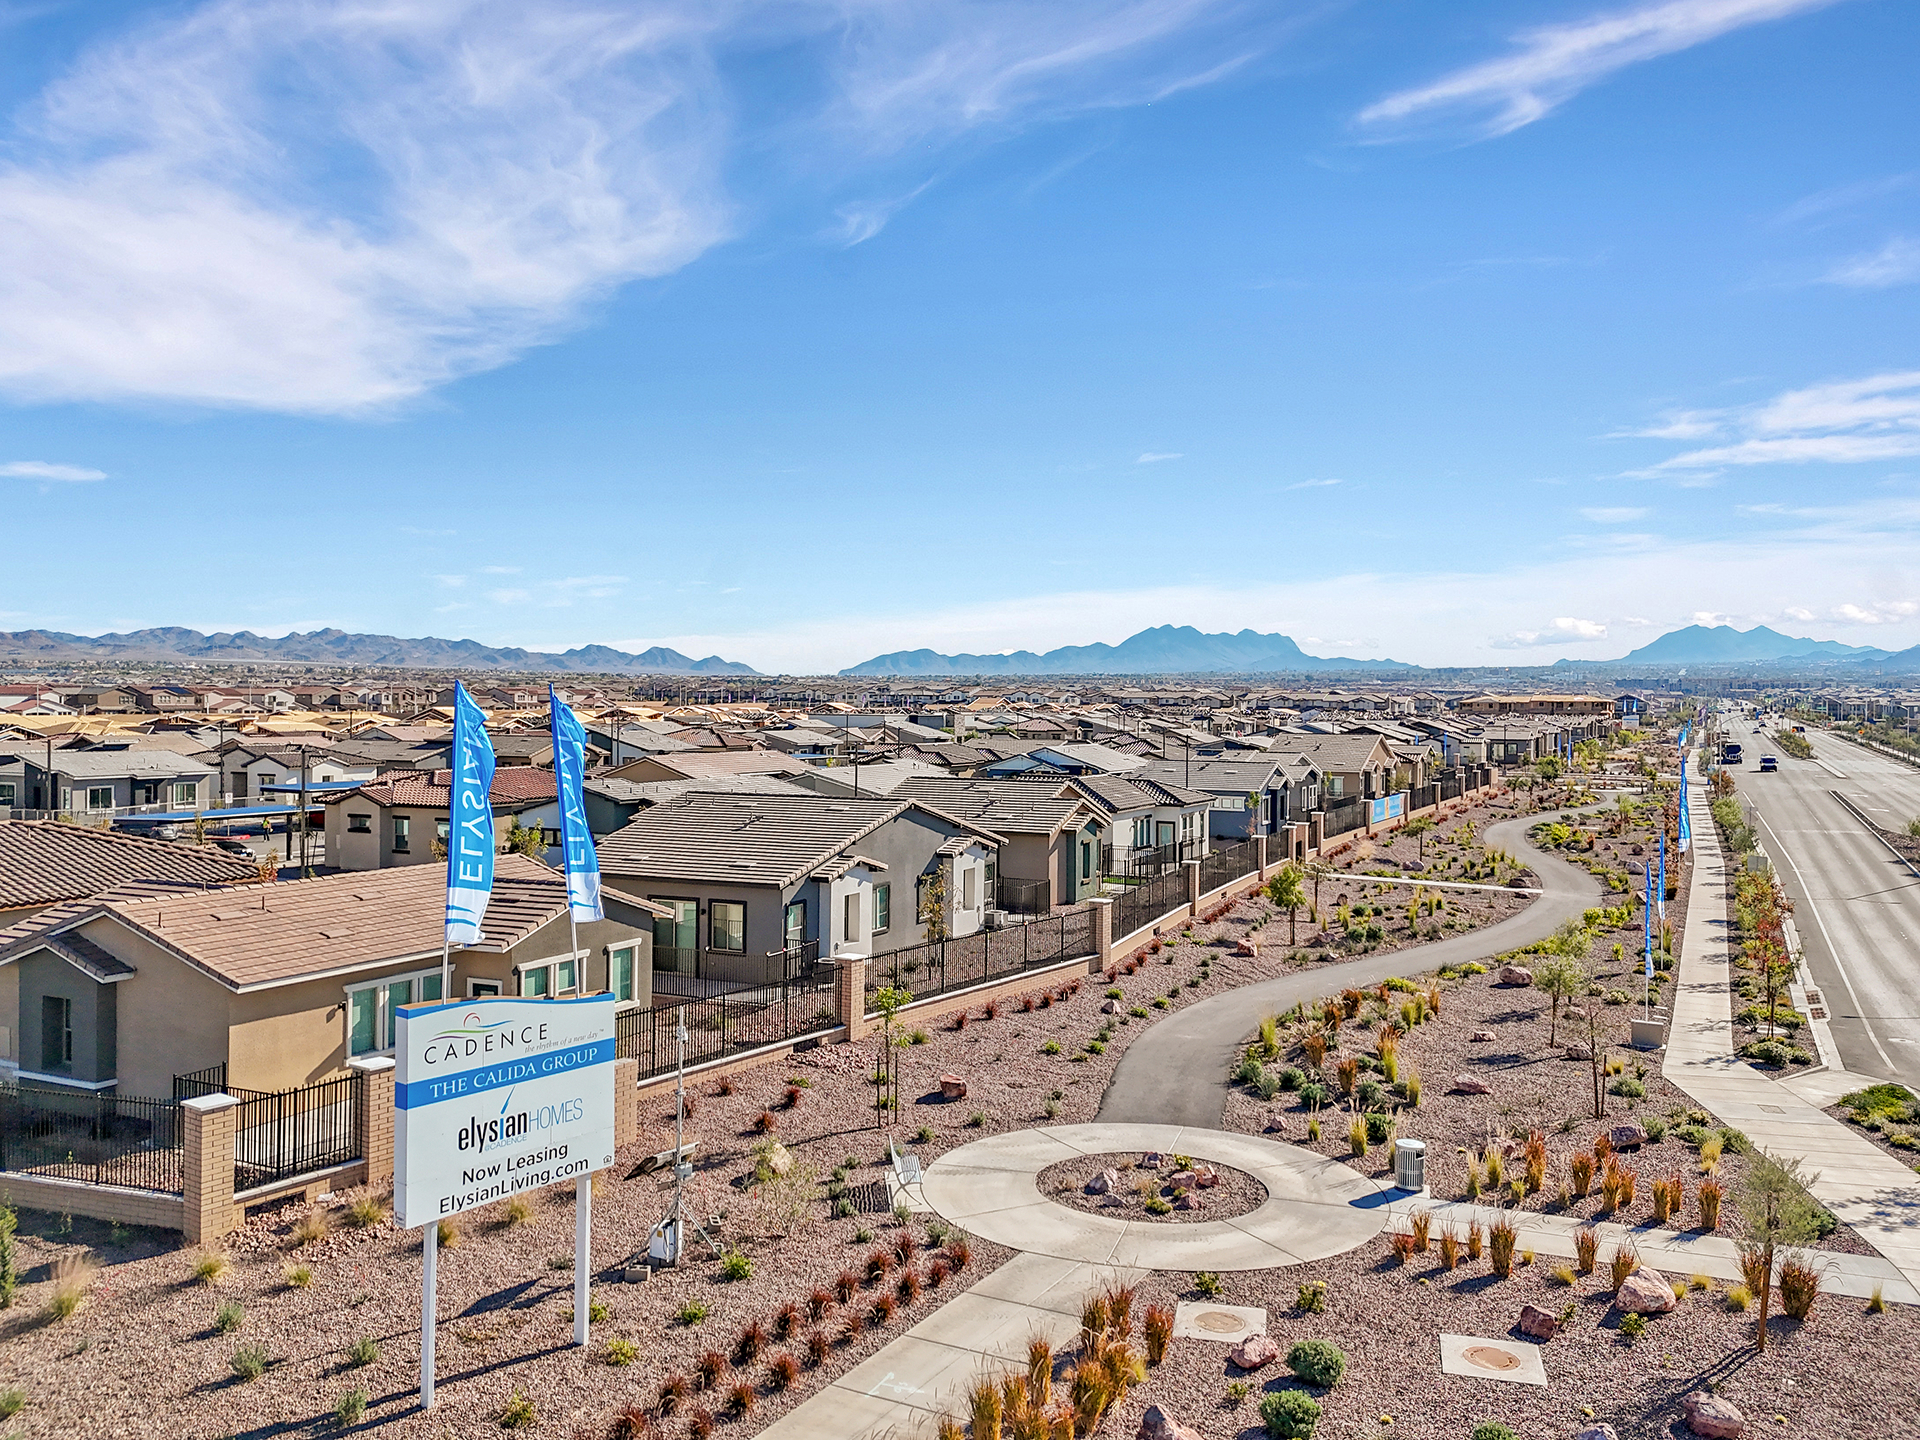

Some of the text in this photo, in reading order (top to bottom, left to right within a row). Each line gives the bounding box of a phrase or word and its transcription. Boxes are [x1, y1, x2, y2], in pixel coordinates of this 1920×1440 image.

[424, 1023, 548, 1064] CADENCE
[429, 1047, 598, 1099] THE CALIDA GROUP
[439, 1158, 590, 1215] ElysianLiving.com
[462, 1144, 569, 1186] Now Leasing
